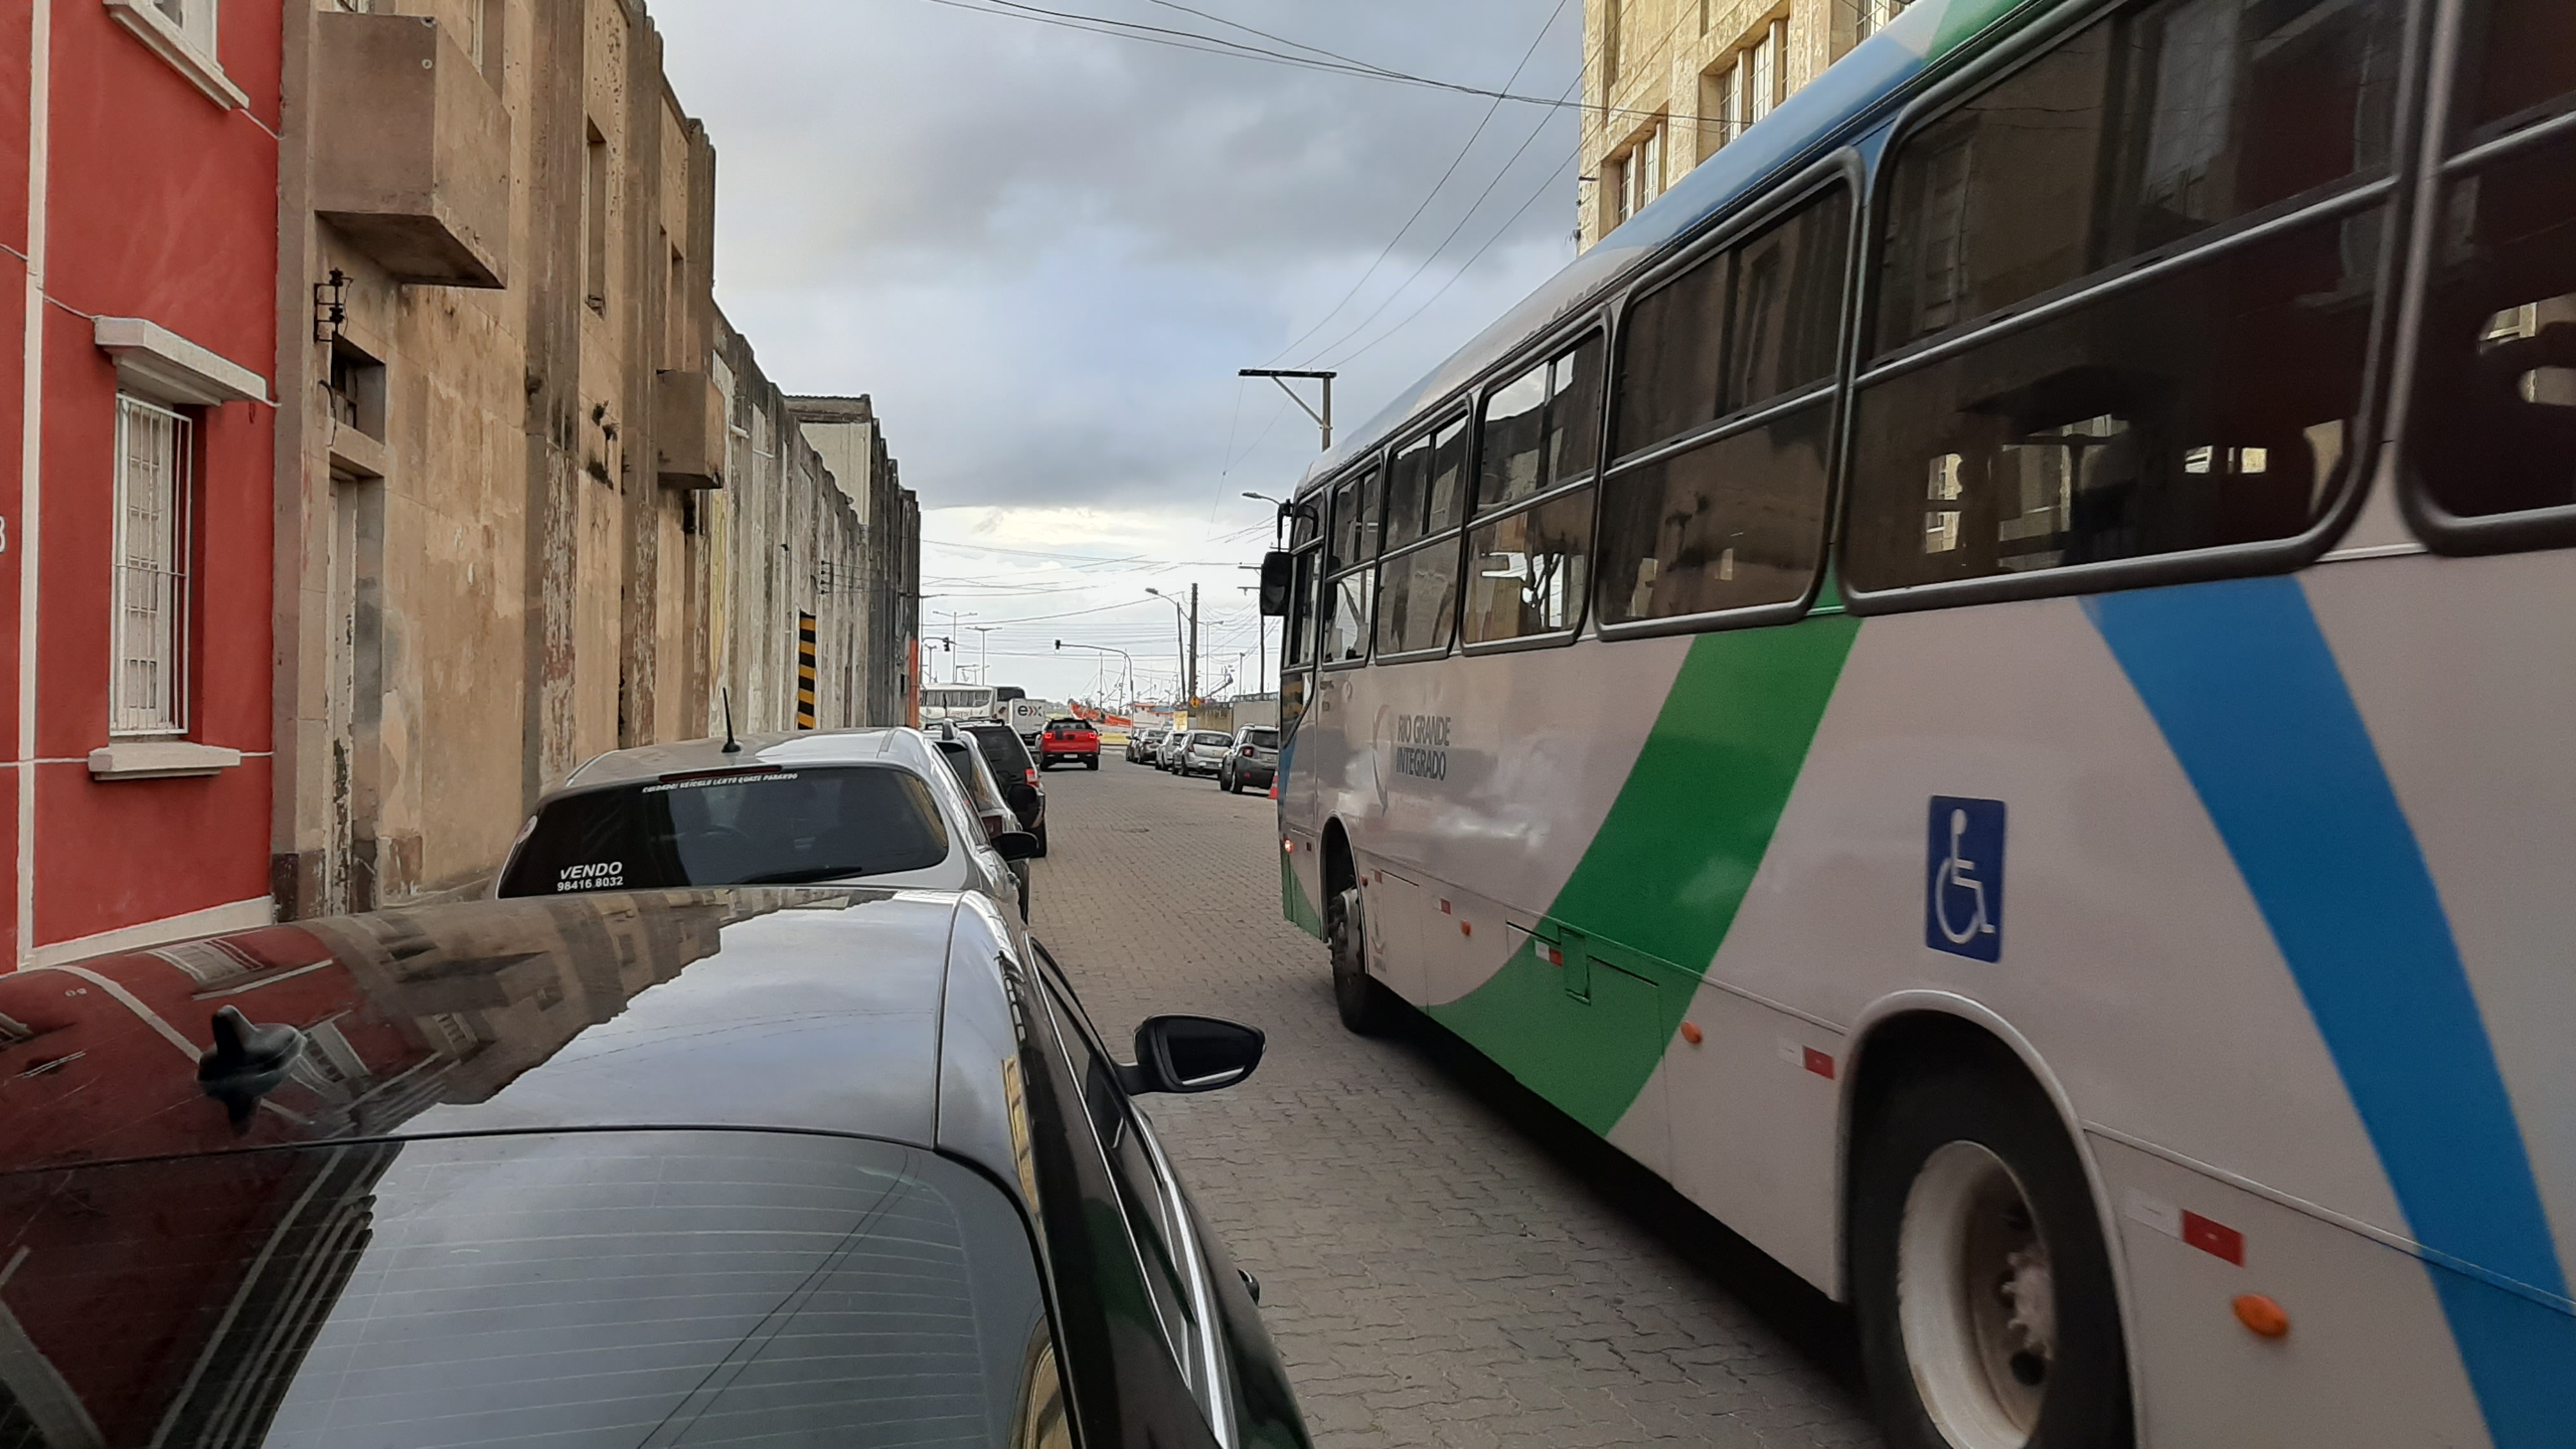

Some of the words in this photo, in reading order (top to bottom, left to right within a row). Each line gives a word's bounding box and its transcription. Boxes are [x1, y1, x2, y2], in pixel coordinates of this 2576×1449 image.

[1397, 714, 1412, 743] RIO
[1413, 715, 1452, 746] GRANDE
[1396, 746, 1446, 781] INTEGRADO
[712, 777, 737, 785] LENTO
[762, 772, 798, 781] PARANDO
[560, 861, 622, 880] VENDO
[556, 879, 592, 891] 98416
[595, 876, 624, 887] 8032
